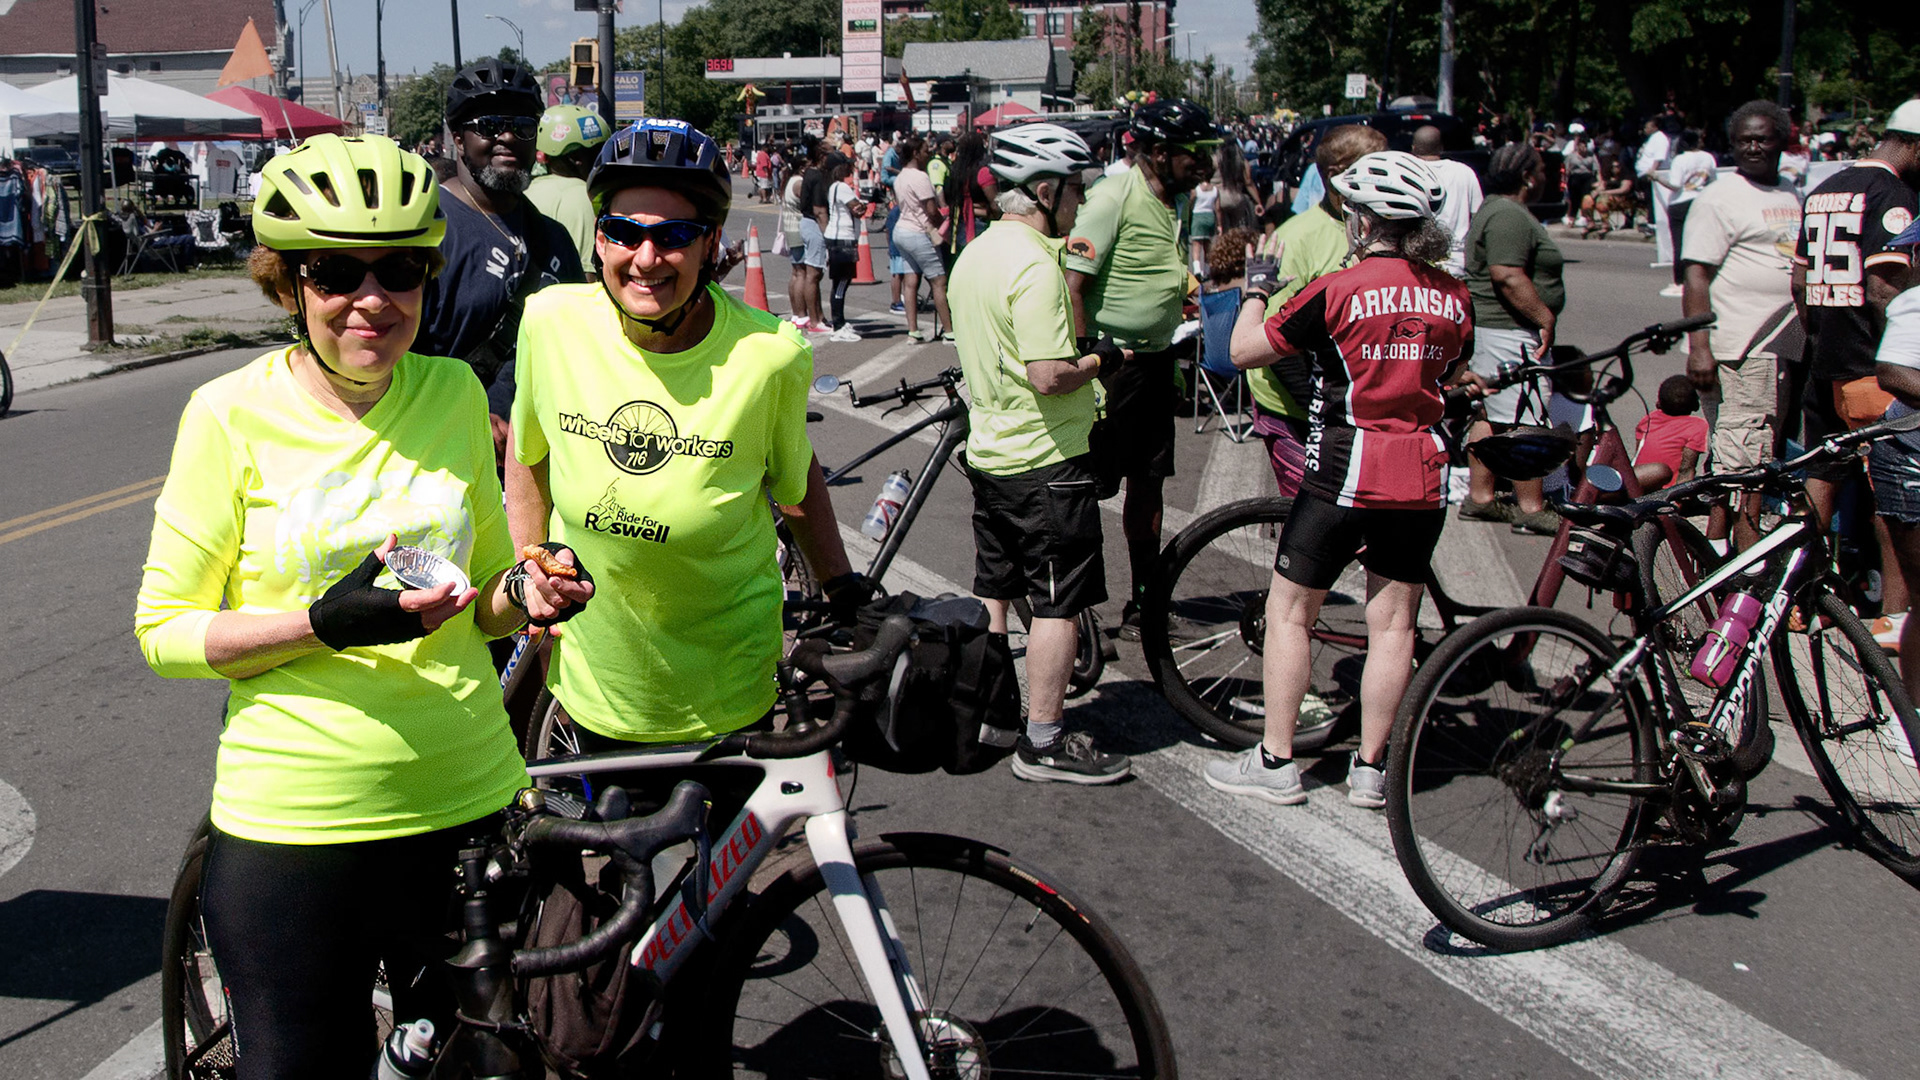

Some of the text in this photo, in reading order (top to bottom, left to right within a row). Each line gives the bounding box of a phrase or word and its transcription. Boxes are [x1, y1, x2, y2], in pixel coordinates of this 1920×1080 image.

[614, 76, 639, 84] FALO
[1348, 86, 1364, 95] 30
[1348, 286, 1466, 325] ARKANSAS
[1361, 343, 1443, 360] RAZORBCKS
[559, 412, 734, 459] wheels for workers
[626, 450, 649, 467] 716
[616, 510, 641, 525] Ride
[584, 511, 671, 544] Roswell
[637, 811, 763, 970] PECILIZED
